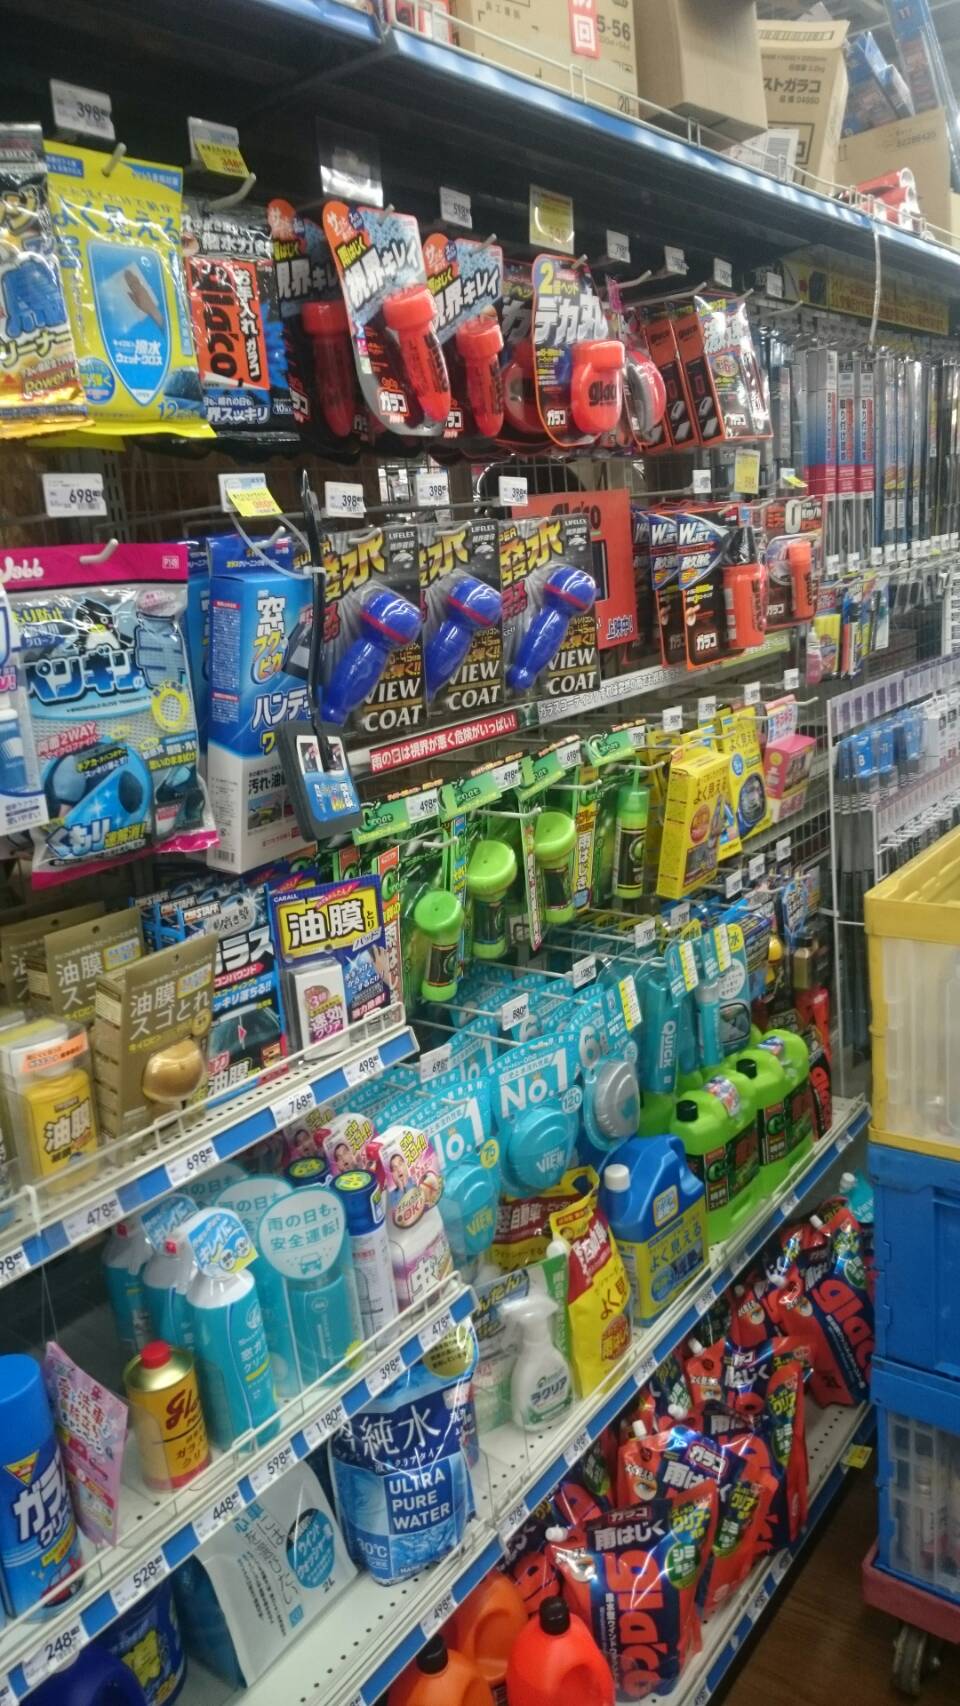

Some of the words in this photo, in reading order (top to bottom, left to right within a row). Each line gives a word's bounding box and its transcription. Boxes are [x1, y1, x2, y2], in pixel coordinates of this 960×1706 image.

[597, 16, 631, 41] 5-56
[76, 102, 101, 121] 398
[69, 488, 92, 505] 698
[342, 494, 358, 508] 398
[429, 485, 443, 498] 398
[549, 648, 595, 671] VIEW
[450, 661, 500, 685] VIEW
[549, 671, 597, 694] COAT
[364, 678, 421, 705] VIEW
[449, 686, 500, 711] COAT
[364, 704, 422, 732] COAT
[371, 713, 517, 770] 雨の日は視界が悪く危険がいっぱい!
[420, 799, 435, 812] 498
[47, 817, 110, 857] くもり
[273, 893, 298, 903] CARALL
[288, 900, 364, 949] 油膜
[367, 910, 377, 930] とり
[56, 952, 104, 987] 油膜
[131, 981, 176, 1018] 油膜
[130, 990, 210, 1041] スゴとれ
[661, 1020, 676, 1070] QUICK
[358, 1058, 376, 1073] 498
[289, 1095, 307, 1113] 768
[187, 1150, 207, 1171] 698
[87, 1205, 111, 1225] 478
[270, 1221, 341, 1251] 安全運転!
[432, 1319, 449, 1336] 478
[380, 1361, 397, 1380] 398
[315, 1410, 338, 1434] 1180
[360, 1404, 441, 1457] 純水
[267, 1453, 288, 1475] 598
[389, 1467, 446, 1495] ULTRA
[212, 1497, 234, 1521] 448
[392, 1492, 438, 1514] PURE
[393, 1503, 451, 1531] WATER
[594, 1520, 666, 1550] 雨はじく
[132, 1560, 156, 1589] 528
[433, 1598, 450, 1618] 498
[46, 1631, 73, 1662] 248
